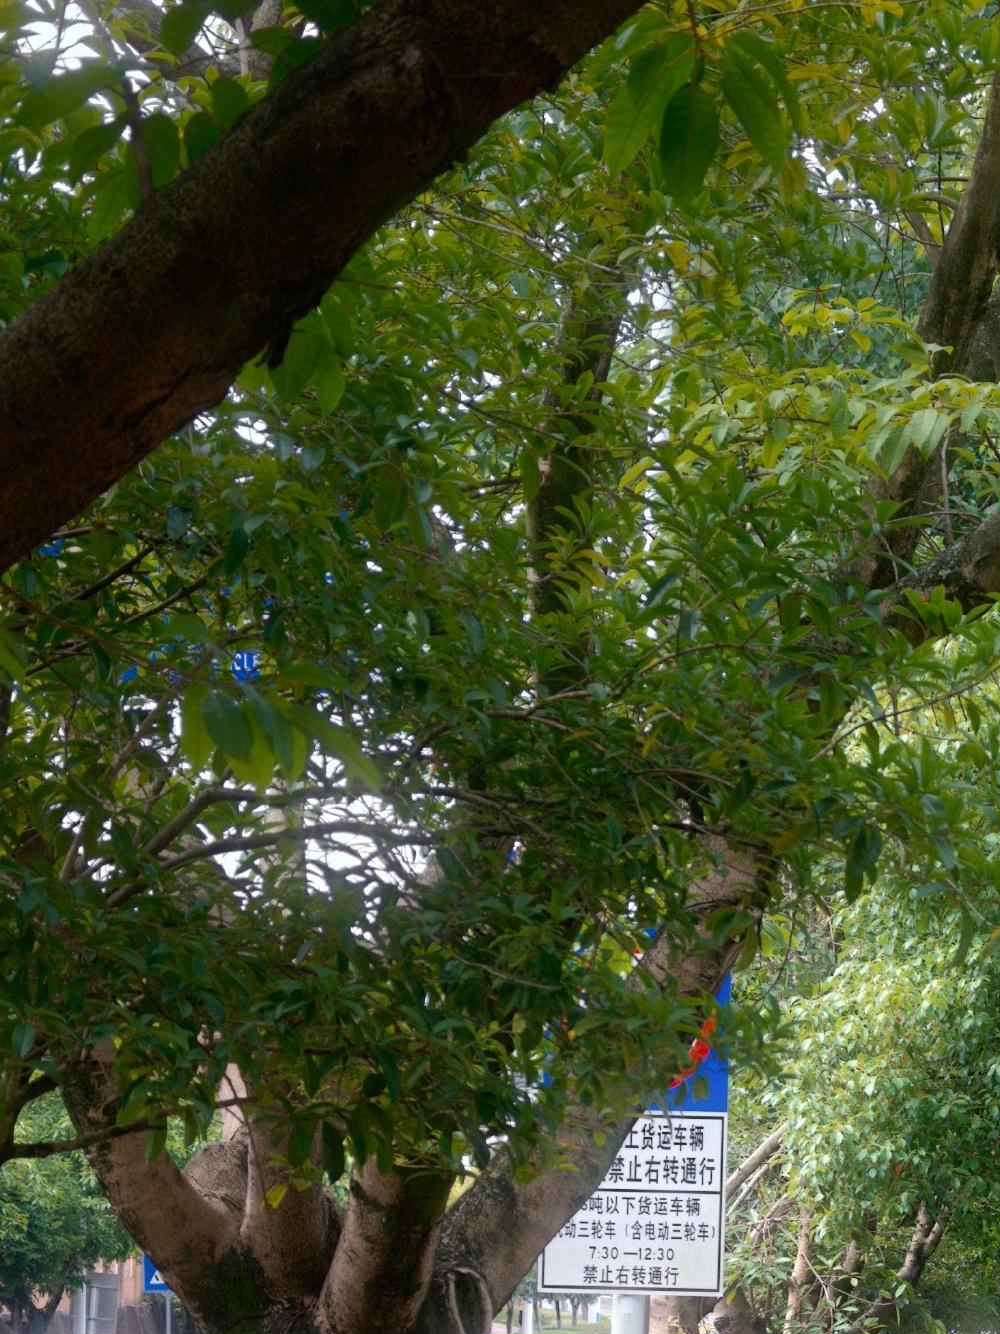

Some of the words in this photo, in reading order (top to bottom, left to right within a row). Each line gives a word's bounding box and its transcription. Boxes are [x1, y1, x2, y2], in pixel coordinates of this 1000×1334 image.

[602, 1154, 716, 1186] 禁止右转通行
[583, 1264, 680, 1286] 禁止右转通行
